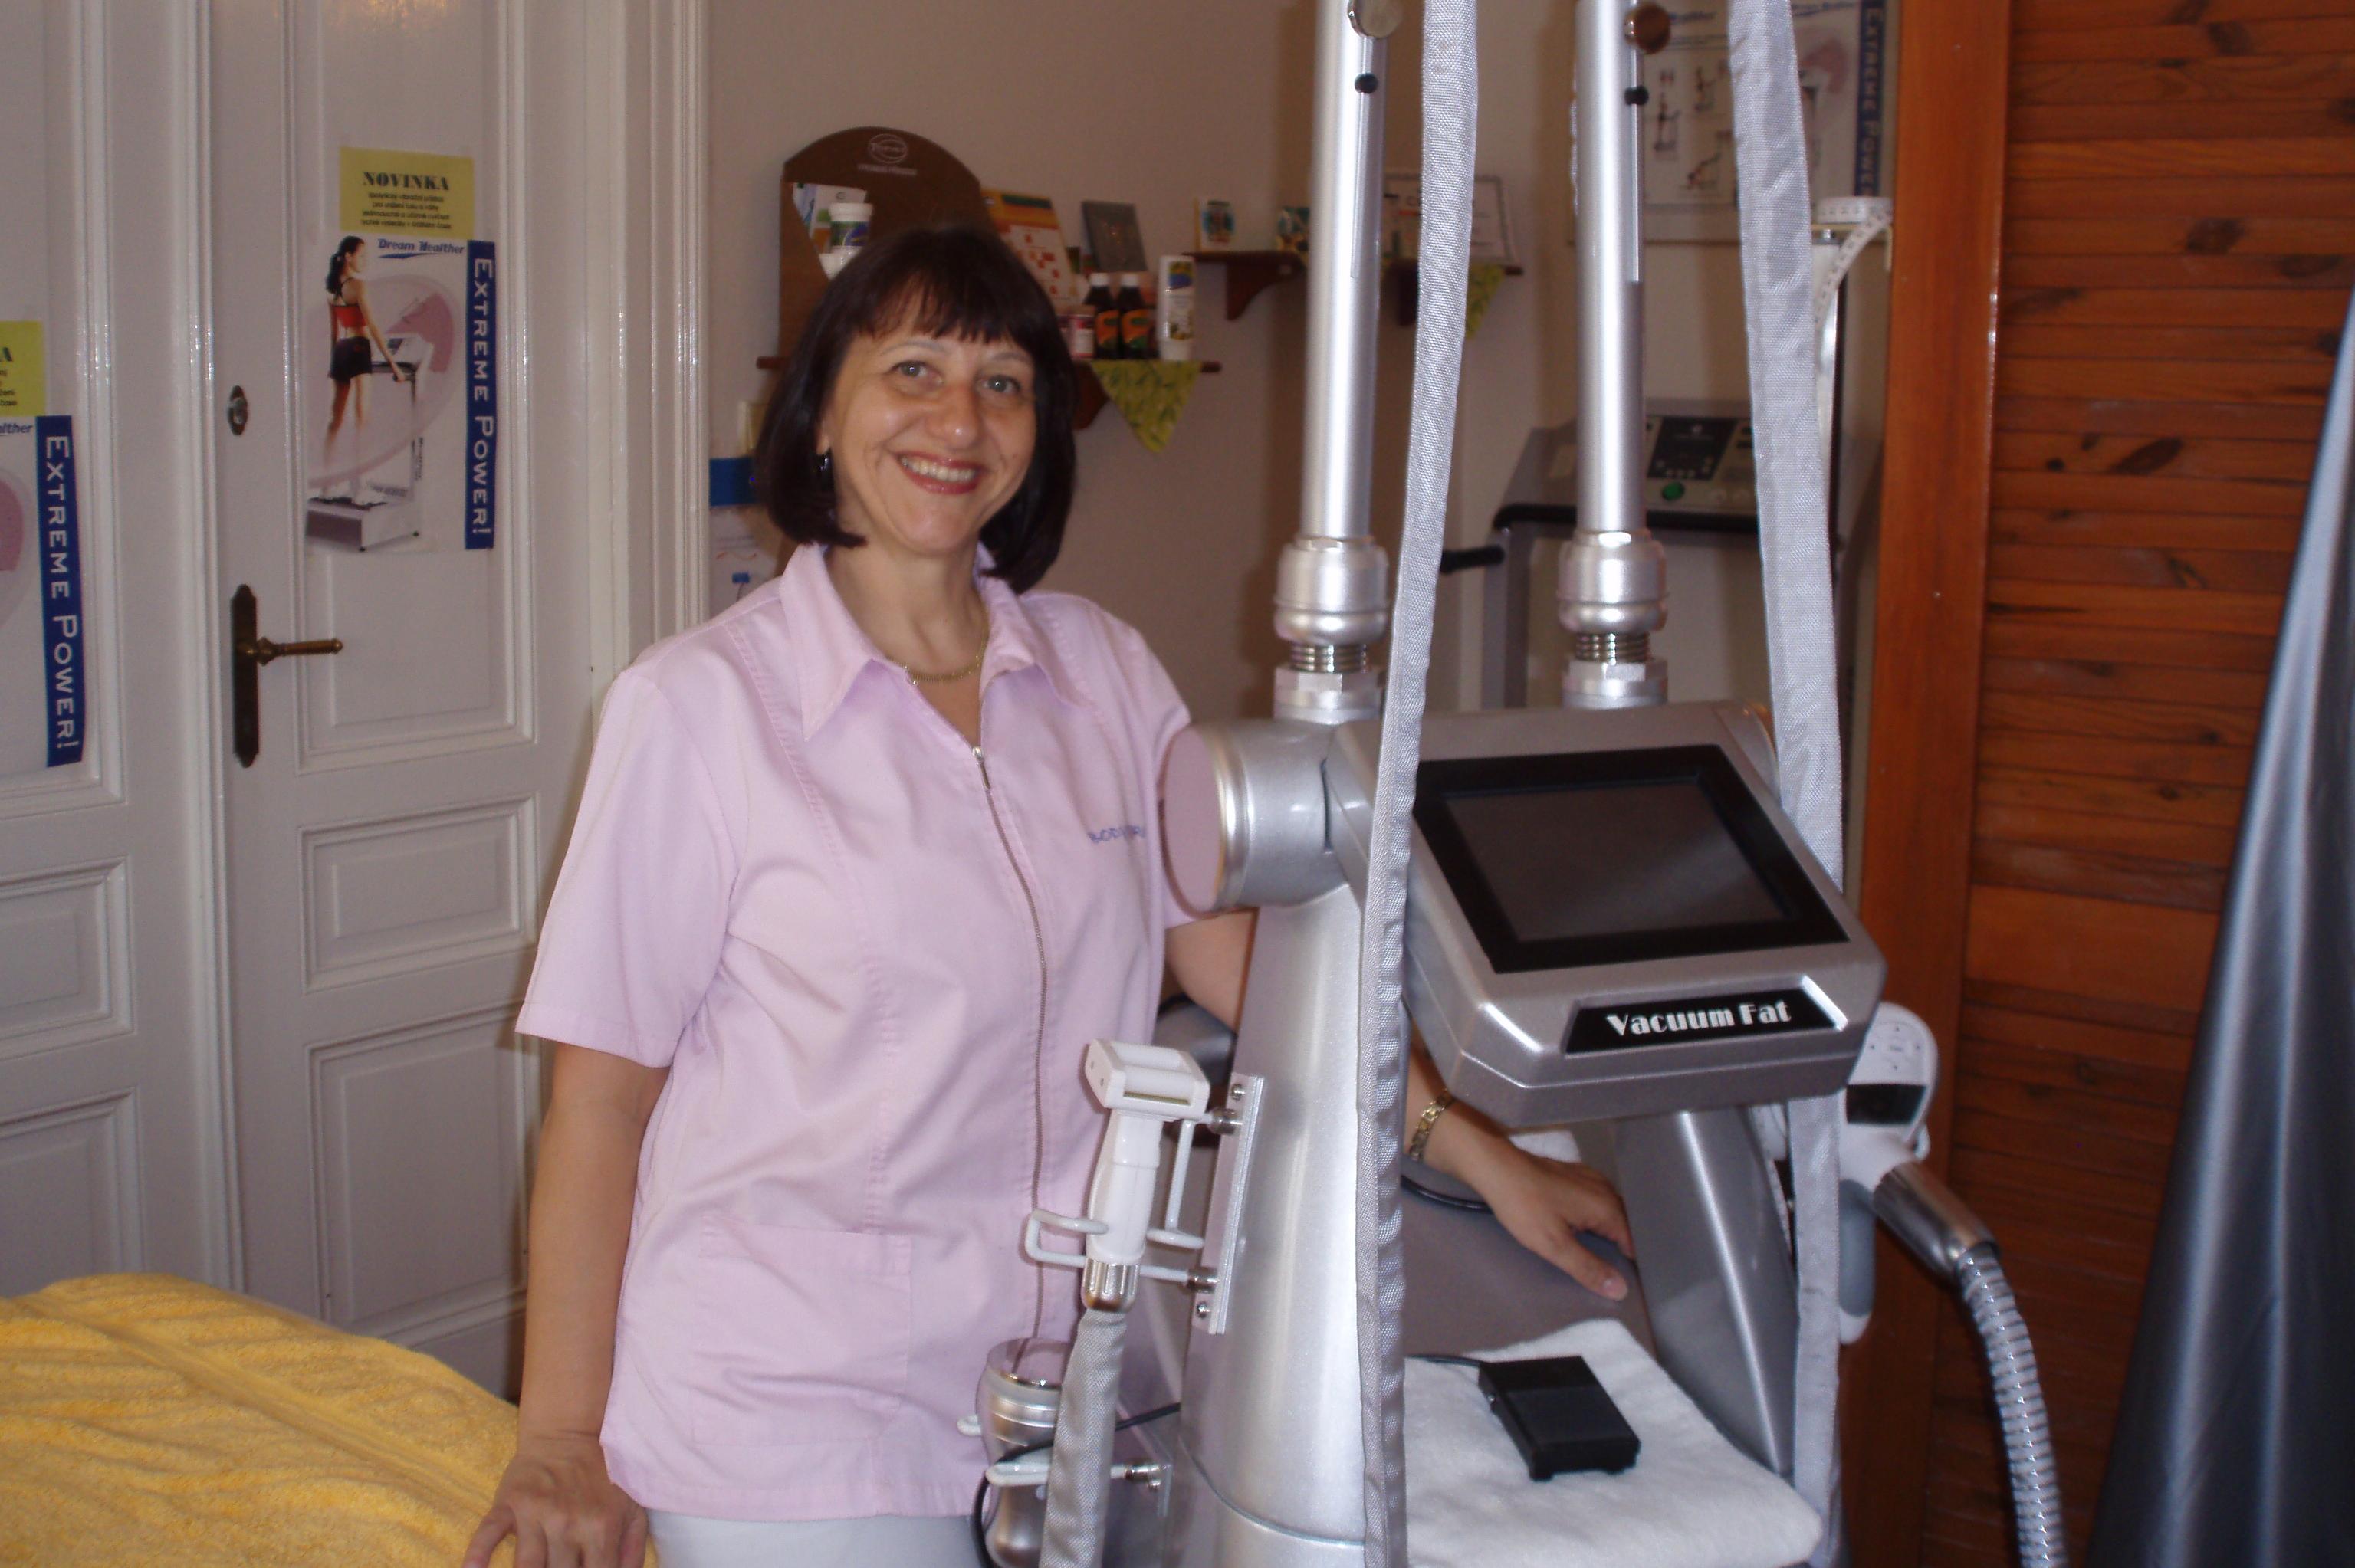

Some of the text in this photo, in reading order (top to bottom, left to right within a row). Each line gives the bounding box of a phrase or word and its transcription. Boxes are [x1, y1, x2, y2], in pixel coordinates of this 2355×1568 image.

[363, 172, 449, 191] NOVINKA
[378, 238, 415, 251] Dream
[473, 258, 494, 533] EXTREME POWER!
[46, 435, 79, 749] EXTREME POWER!
[1606, 999, 1792, 1036] Vacuum Fat
